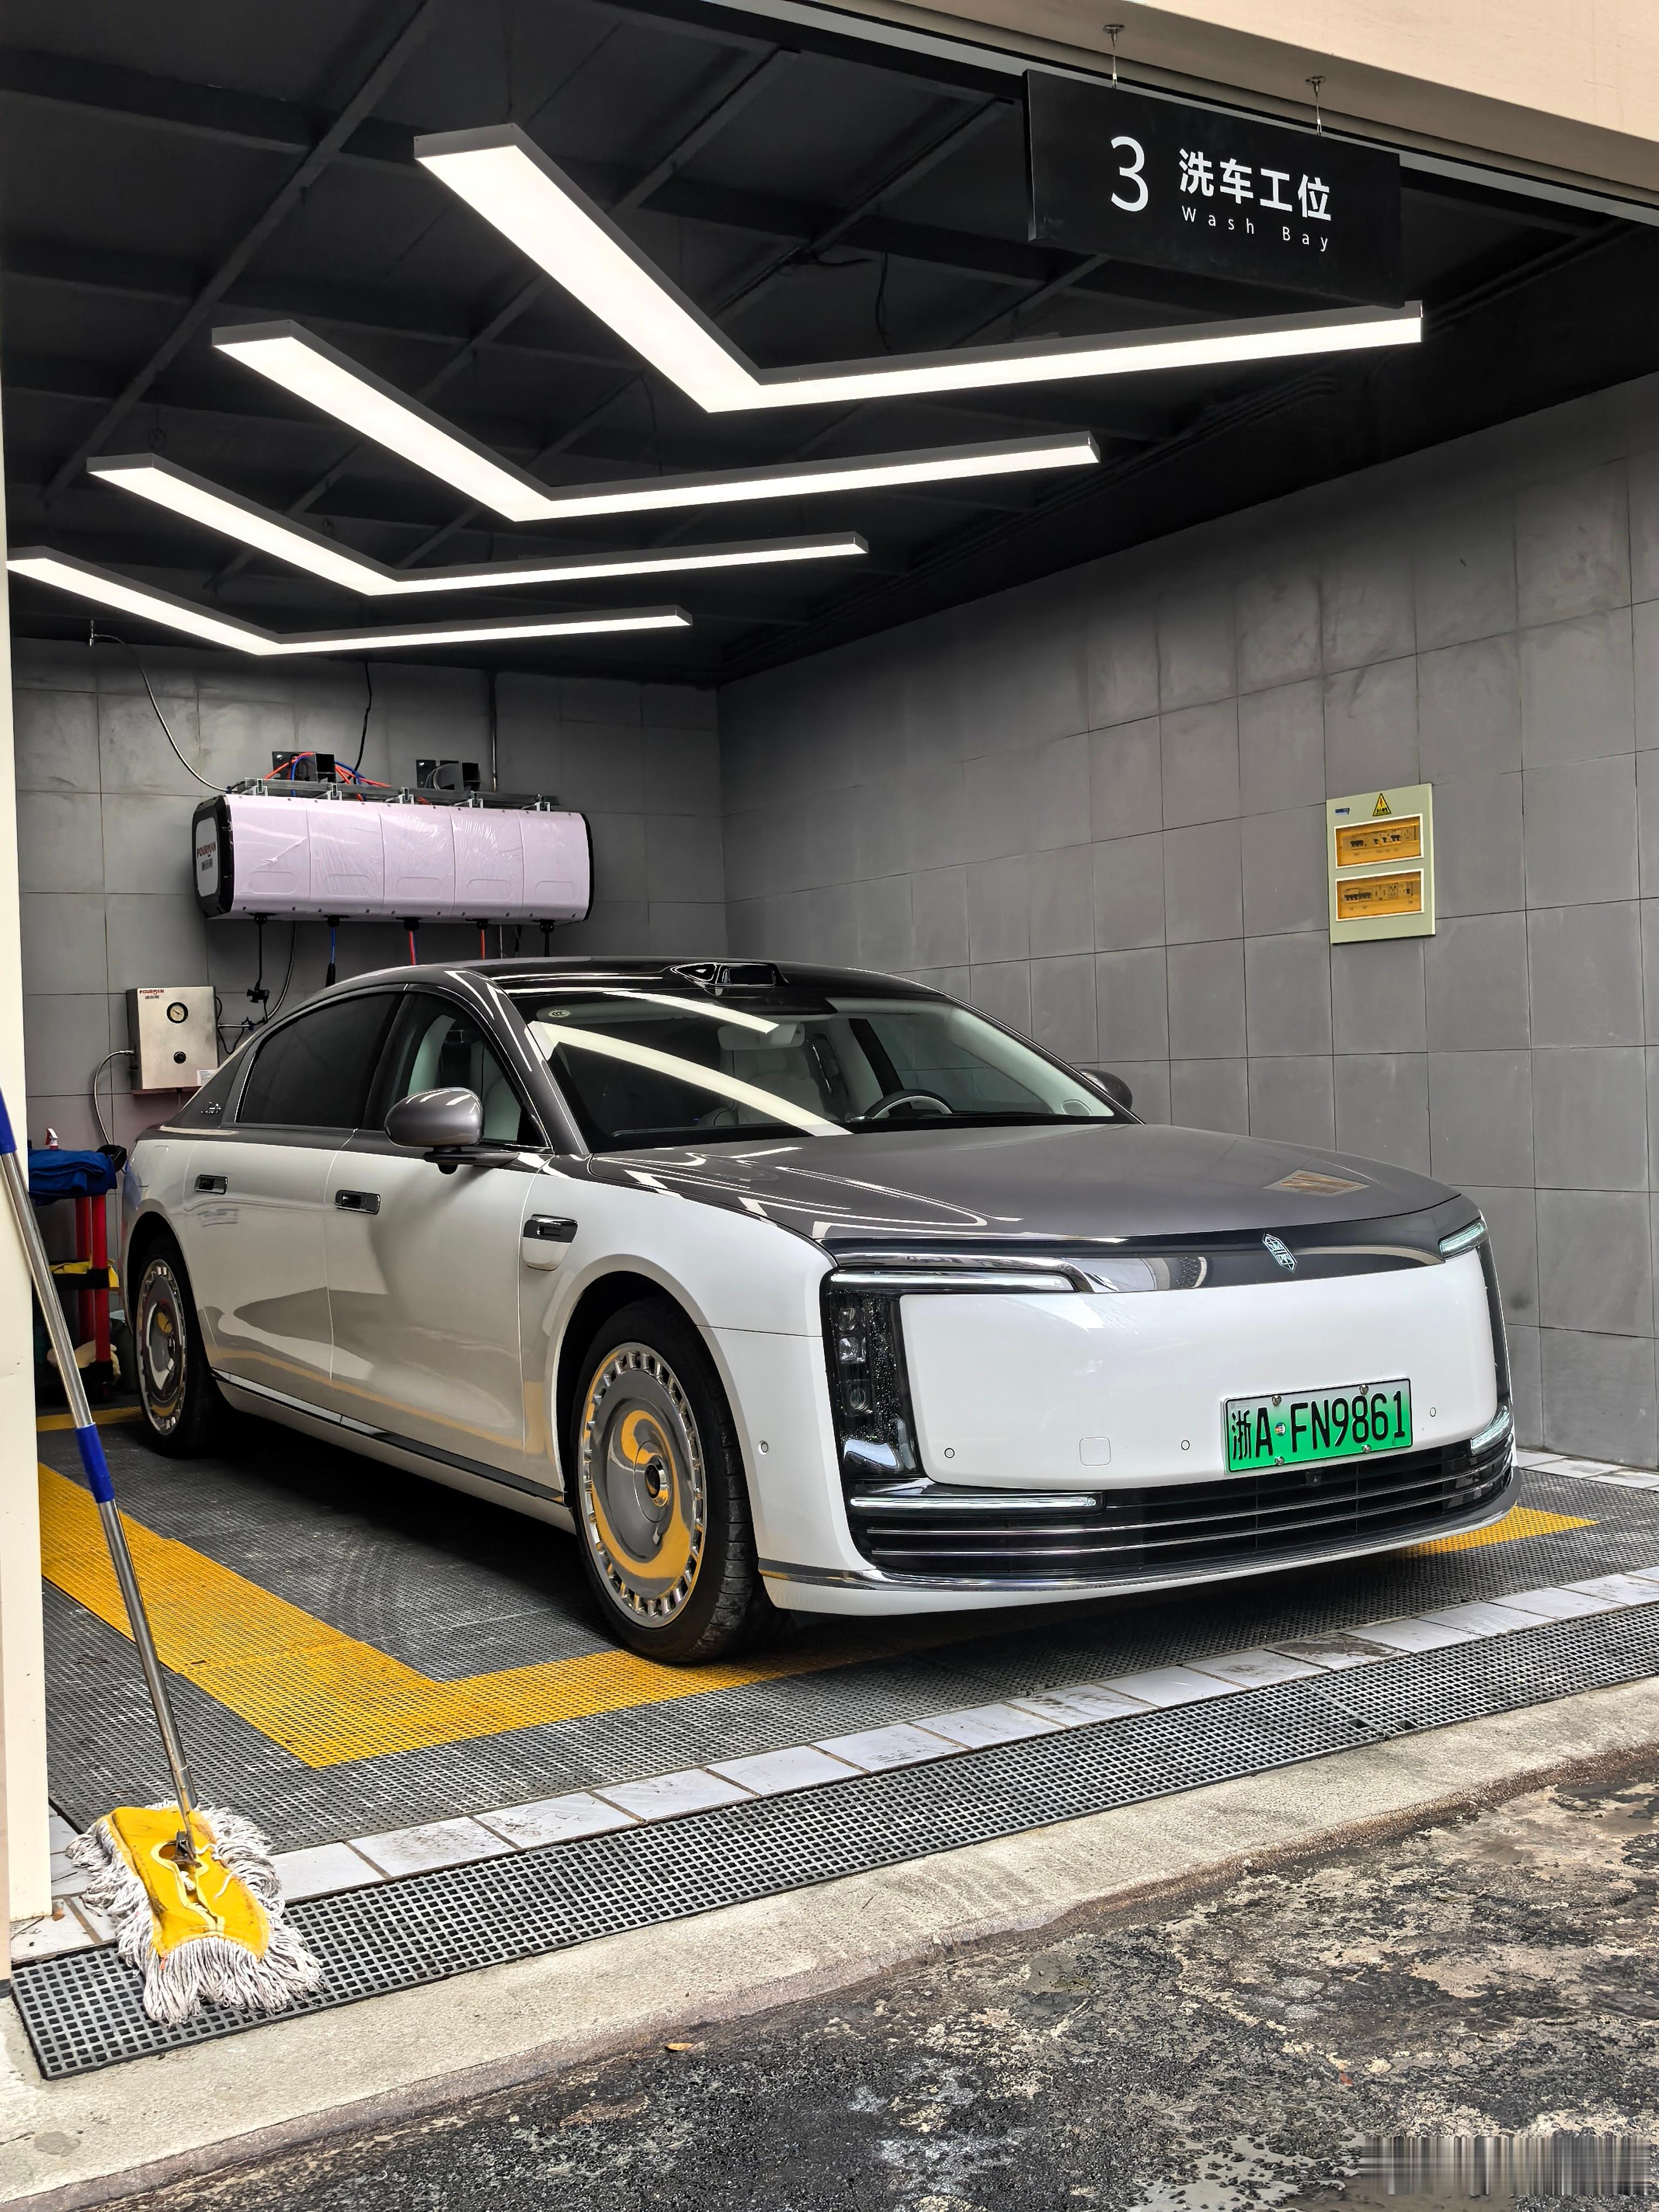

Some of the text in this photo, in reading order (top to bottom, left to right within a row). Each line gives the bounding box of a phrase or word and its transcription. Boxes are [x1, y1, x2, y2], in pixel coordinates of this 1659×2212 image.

[1111, 135, 1331, 221] 3 洗车工位
[1182, 205, 1328, 252] Wash Bay
